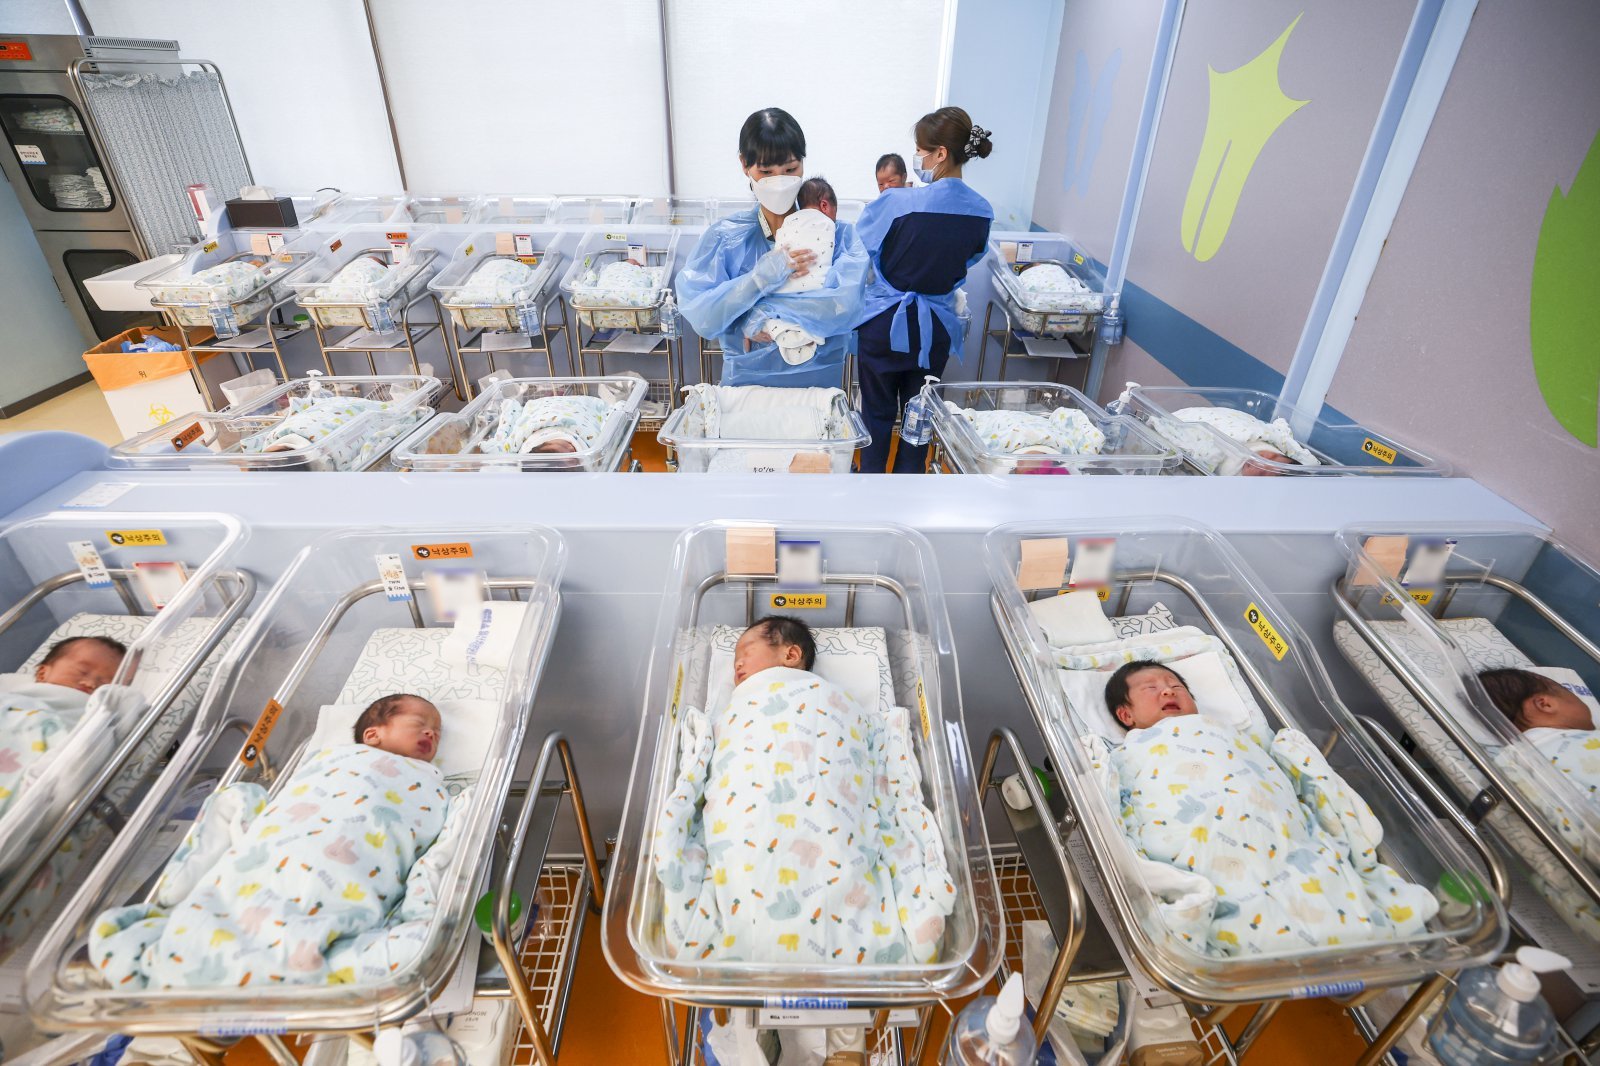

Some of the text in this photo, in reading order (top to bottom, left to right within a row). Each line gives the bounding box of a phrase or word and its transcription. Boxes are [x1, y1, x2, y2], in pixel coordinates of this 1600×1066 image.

[1373, 445, 1393, 460] 낙상주의
[125, 533, 161, 542] 낙상주의
[431, 546, 469, 555] 낙상주의
[788, 597, 822, 606] 낙상주의
[1258, 620, 1284, 655] 낙상주의
[254, 704, 279, 743] 낙상주의
